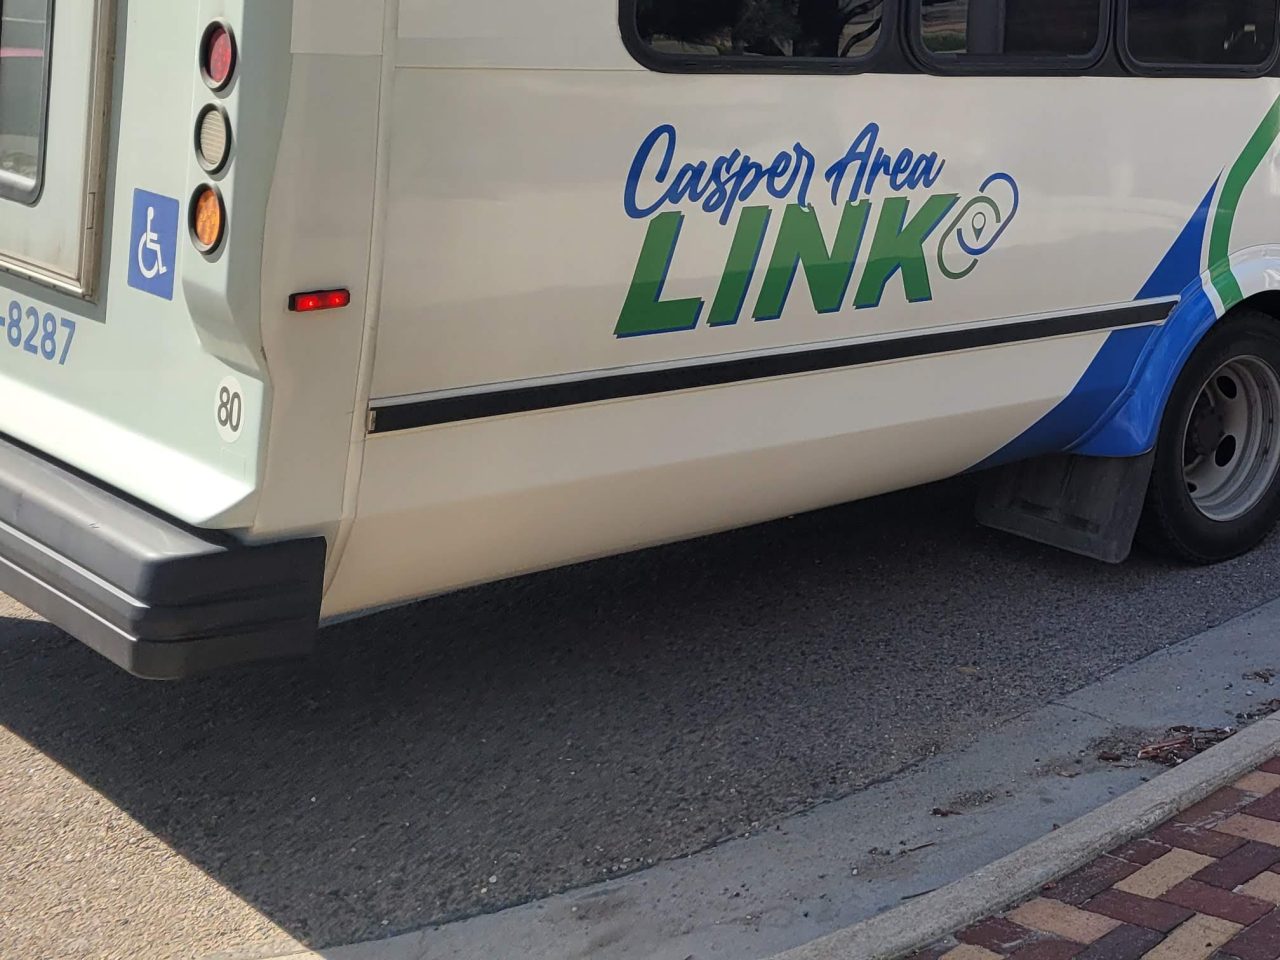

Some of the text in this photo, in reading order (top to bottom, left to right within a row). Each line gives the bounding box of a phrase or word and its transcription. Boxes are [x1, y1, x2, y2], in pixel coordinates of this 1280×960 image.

[623, 122, 946, 226] Casper Area
[613, 193, 961, 339] LINK
[217, 386, 242, 433] 80
